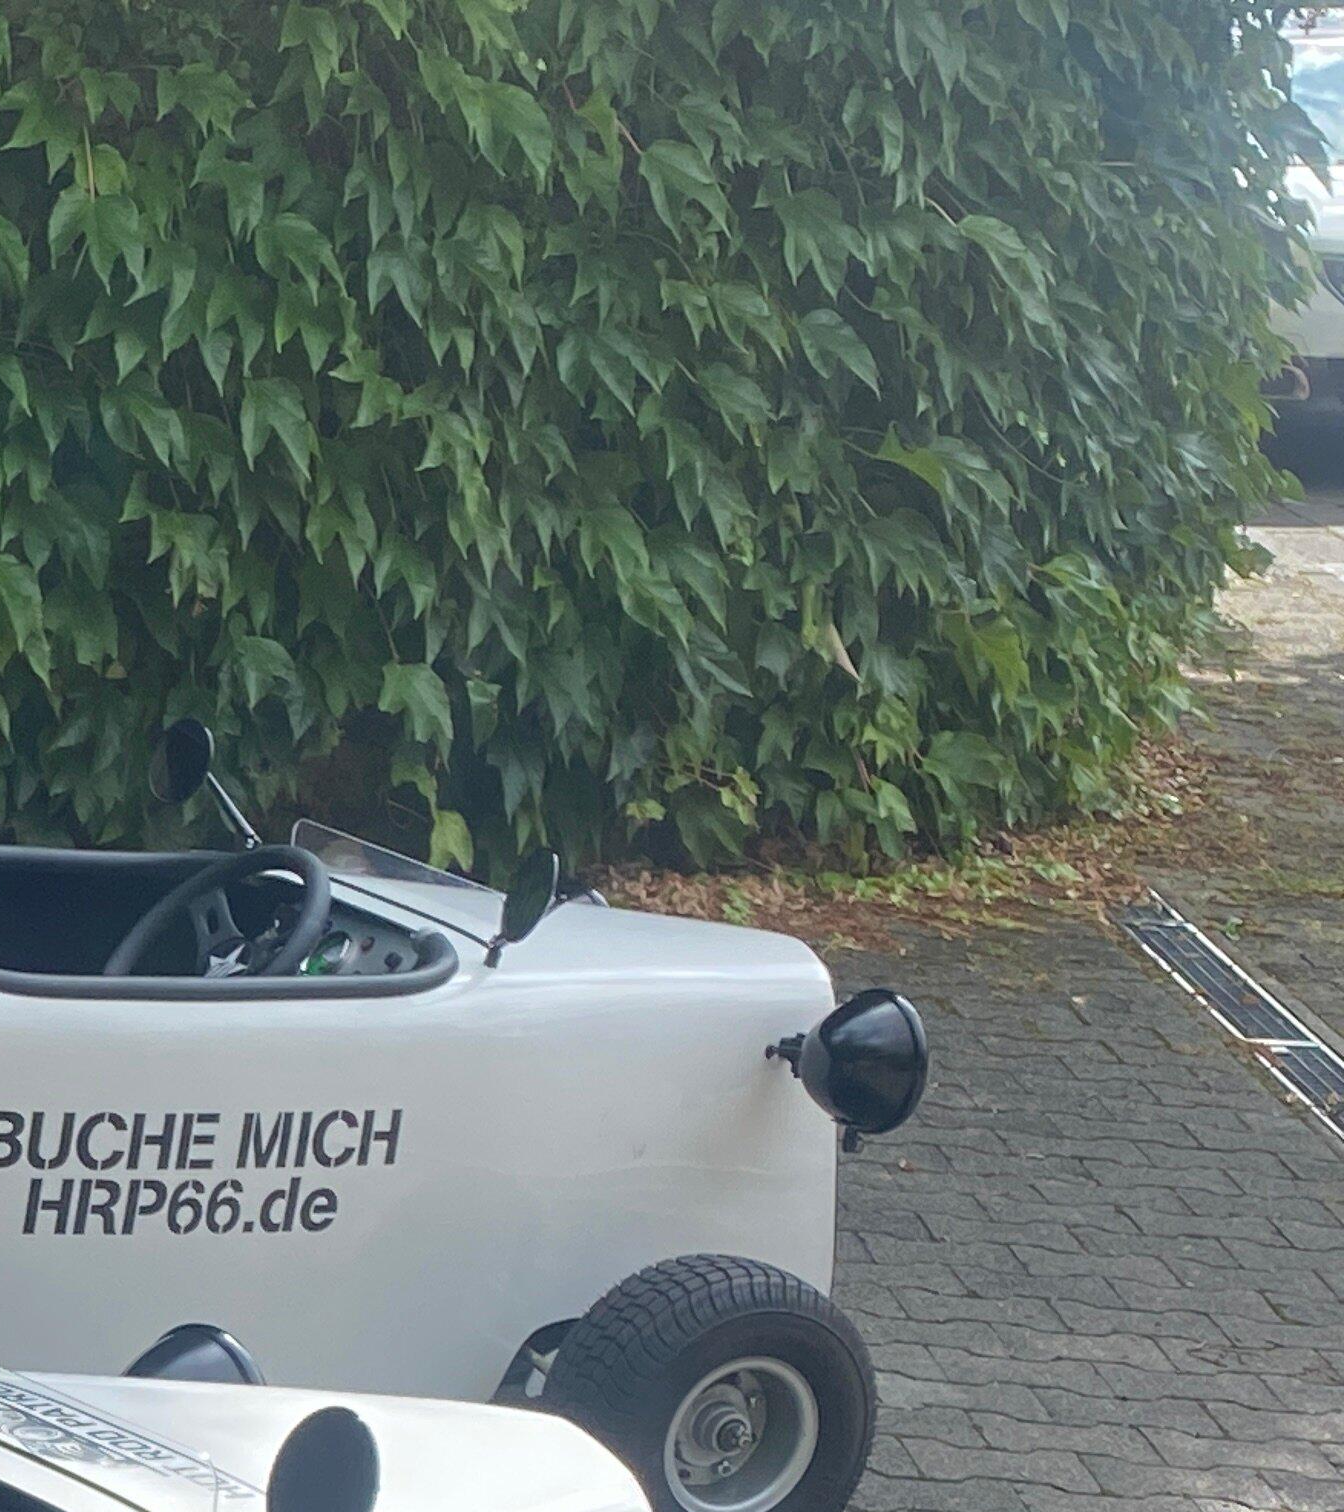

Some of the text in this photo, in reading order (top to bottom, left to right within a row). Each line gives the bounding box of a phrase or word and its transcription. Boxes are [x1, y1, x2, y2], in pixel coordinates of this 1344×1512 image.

[236, 1109, 402, 1169] MICH
[23, 1176, 338, 1236] HRP66.de
[88, 1430, 175, 1462] ROD
